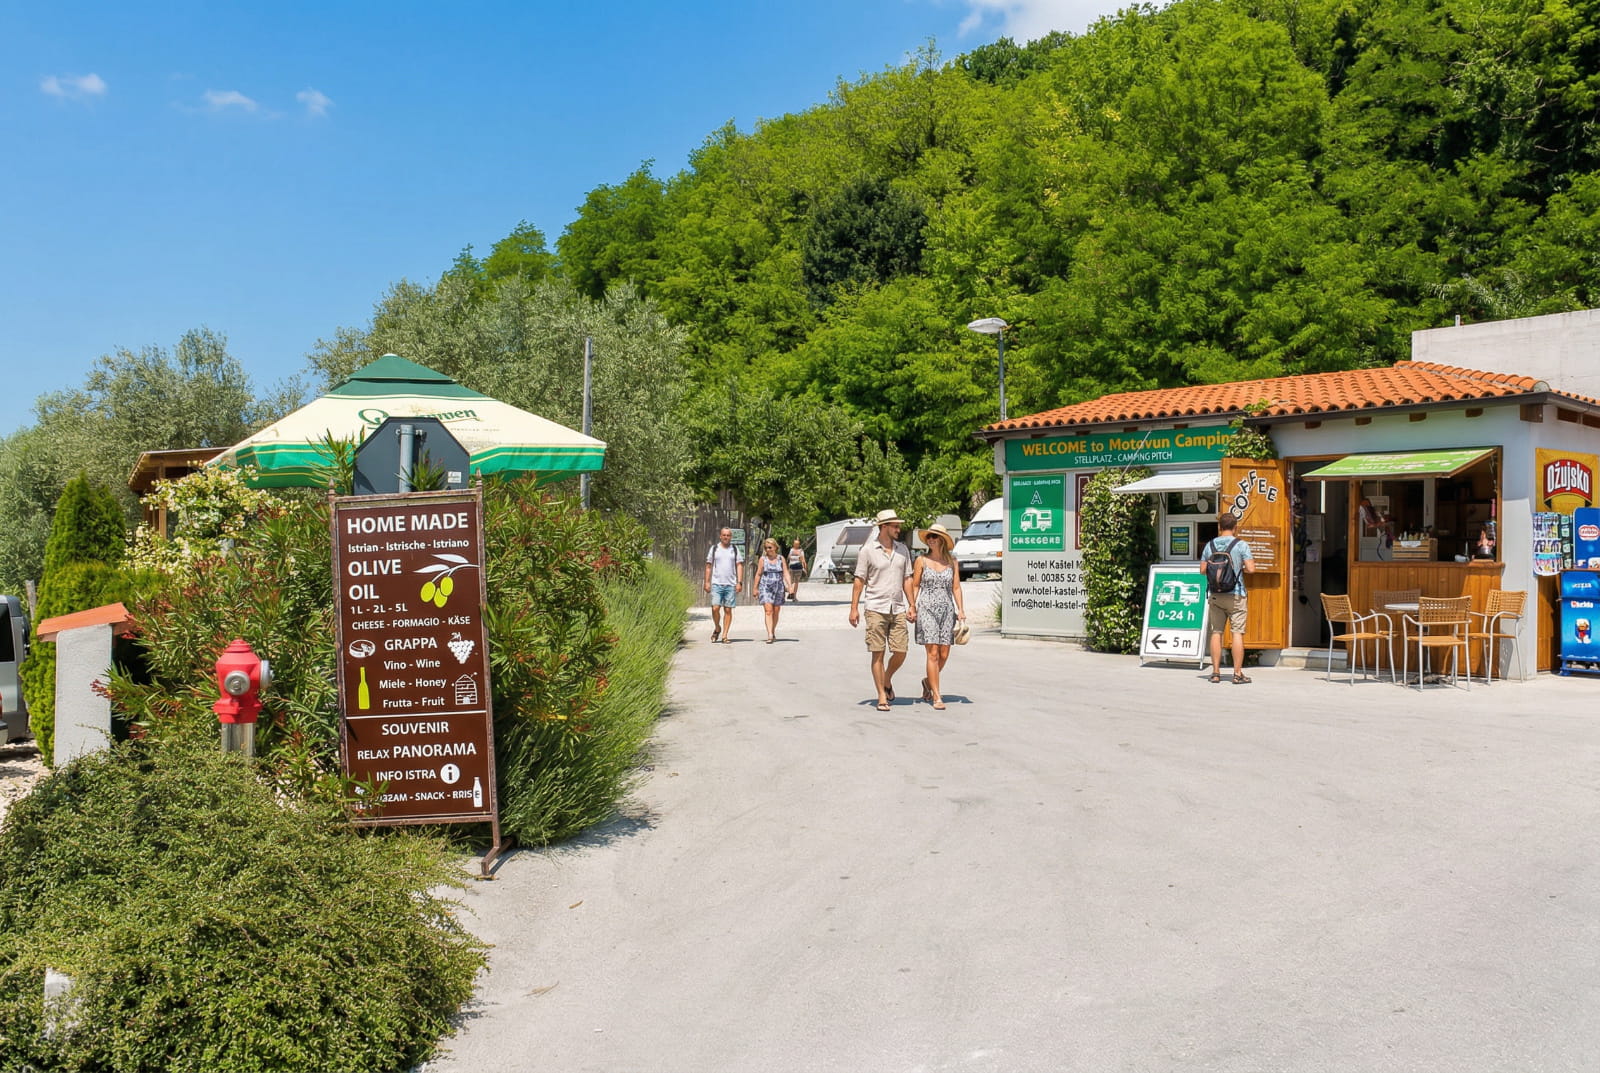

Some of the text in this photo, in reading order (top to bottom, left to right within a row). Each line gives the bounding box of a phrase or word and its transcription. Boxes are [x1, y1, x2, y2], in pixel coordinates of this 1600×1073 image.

[1022, 431, 1232, 456] WELCOME to Motovun Campin
[1075, 454, 1112, 464] STELLPLATZ
[1118, 452, 1150, 462] CAMPING
[1152, 451, 1172, 460] PITCH
[1547, 461, 1589, 493] Ožujsko
[1230, 470, 1277, 520] COFFEE
[347, 512, 468, 534] HOME MADE
[348, 543, 379, 553] Istrian
[386, 541, 426, 551] Istrische
[433, 539, 469, 549] Istriano
[348, 559, 402, 576] OLIVE
[1028, 560, 1048, 569] Hotel
[1050, 560, 1074, 569] Kaštel
[1028, 573, 1039, 582] tel.
[1041, 573, 1065, 582] 00385
[1067, 574, 1076, 582] 52
[349, 584, 379, 600] OIL
[373, 605, 386, 613] 2L
[395, 603, 408, 612] 5L
[1158, 610, 1195, 621] 0-24 h
[352, 620, 385, 630] CHEESE
[392, 618, 439, 628] FORMAGIO
[448, 615, 471, 625] KÄSE
[384, 636, 438, 651] GRAPPA
[1173, 636, 1192, 648] 5 m
[384, 661, 407, 670] Vino
[415, 659, 441, 669] Wine
[379, 679, 406, 689] Miele
[415, 678, 447, 689] Honey
[383, 699, 412, 708] Frutta
[421, 696, 445, 706] Fruit
[381, 721, 449, 736] SOUVENIR
[357, 742, 477, 760] RELAX PANORAMA
[376, 771, 403, 782] INFO
[405, 769, 436, 780] ISTRA
[415, 791, 445, 801] SNACK
